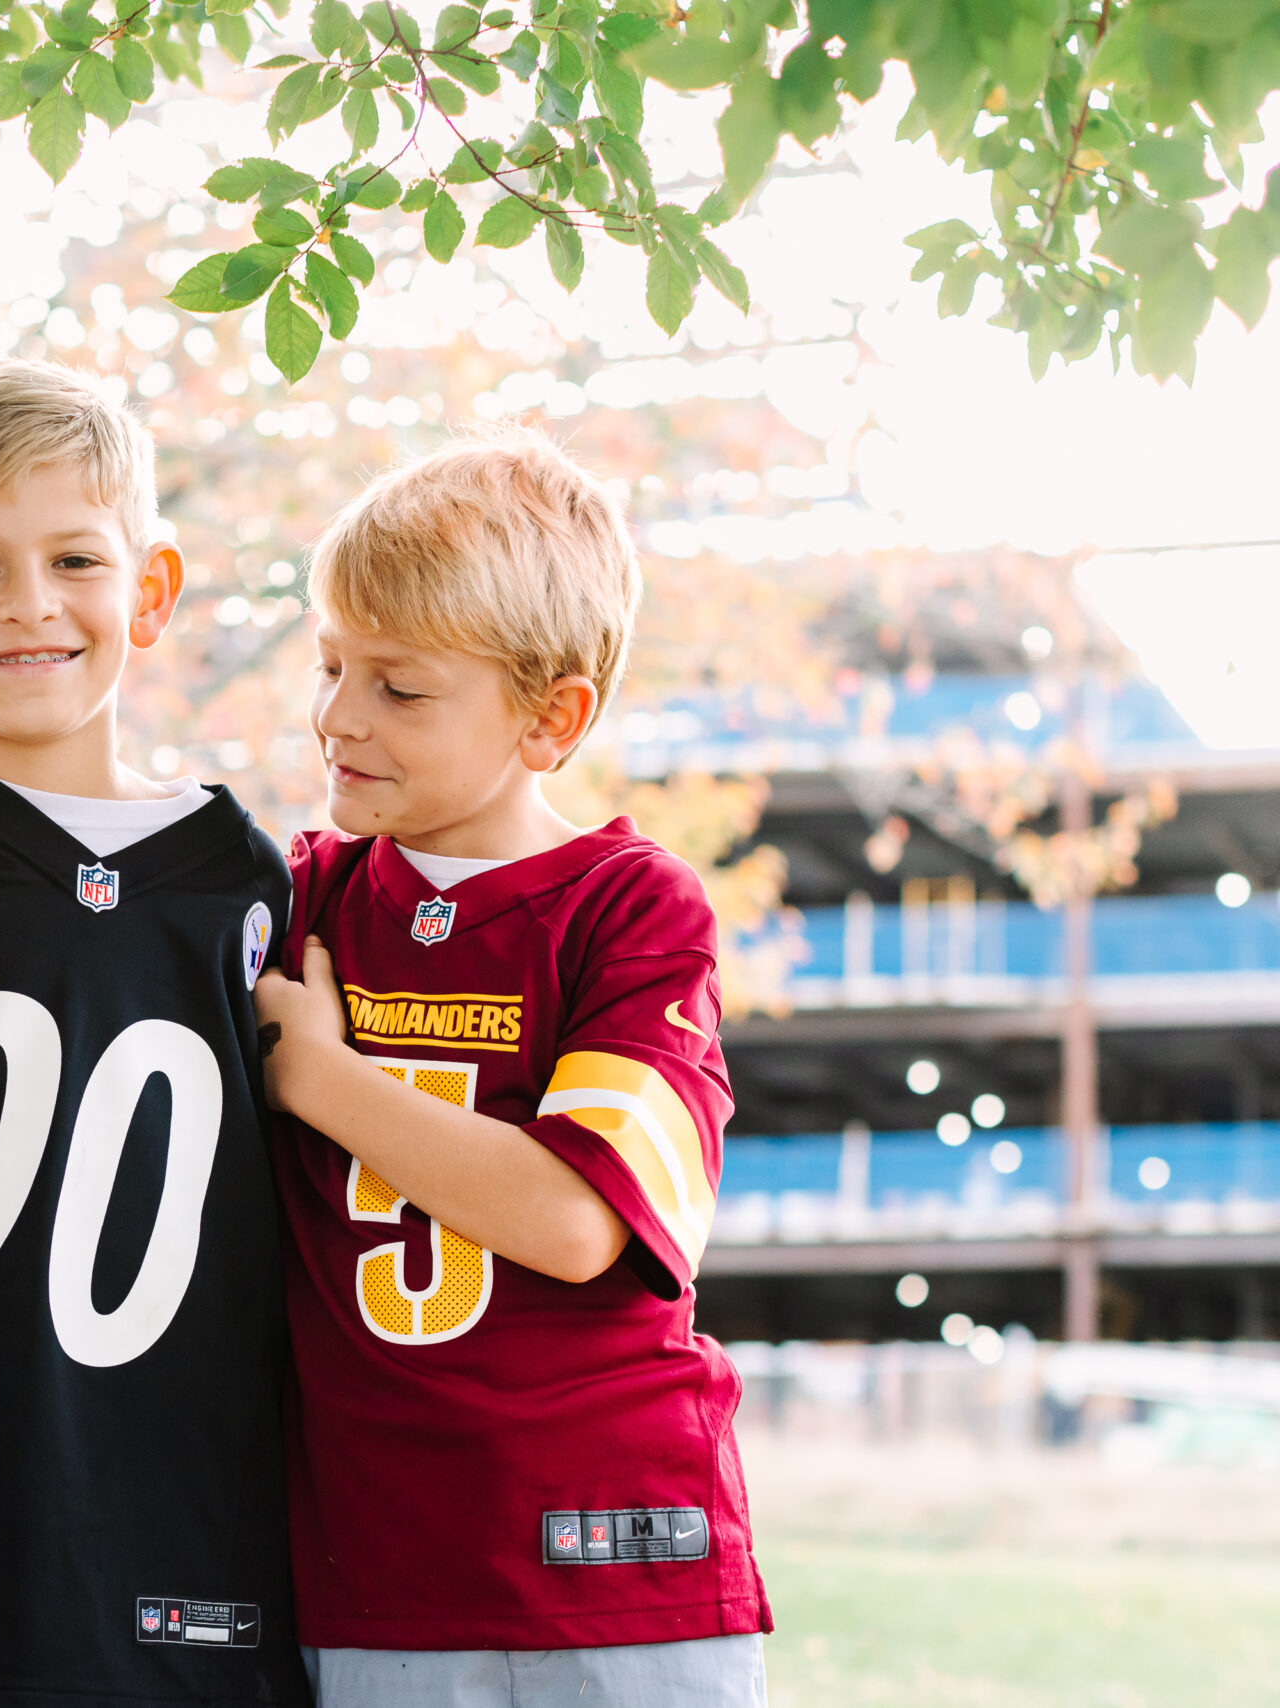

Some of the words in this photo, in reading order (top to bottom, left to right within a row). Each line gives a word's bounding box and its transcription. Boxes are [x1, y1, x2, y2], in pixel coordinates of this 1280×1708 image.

[84, 882, 112, 903] NFL
[416, 918, 444, 937] NFL
[347, 994, 522, 1042] OMMANDERS
[631, 1517, 654, 1537] M
[557, 1535, 576, 1548] NFL
[187, 1604, 230, 1613] ENGINEERED
[144, 1618, 158, 1629] NFL
